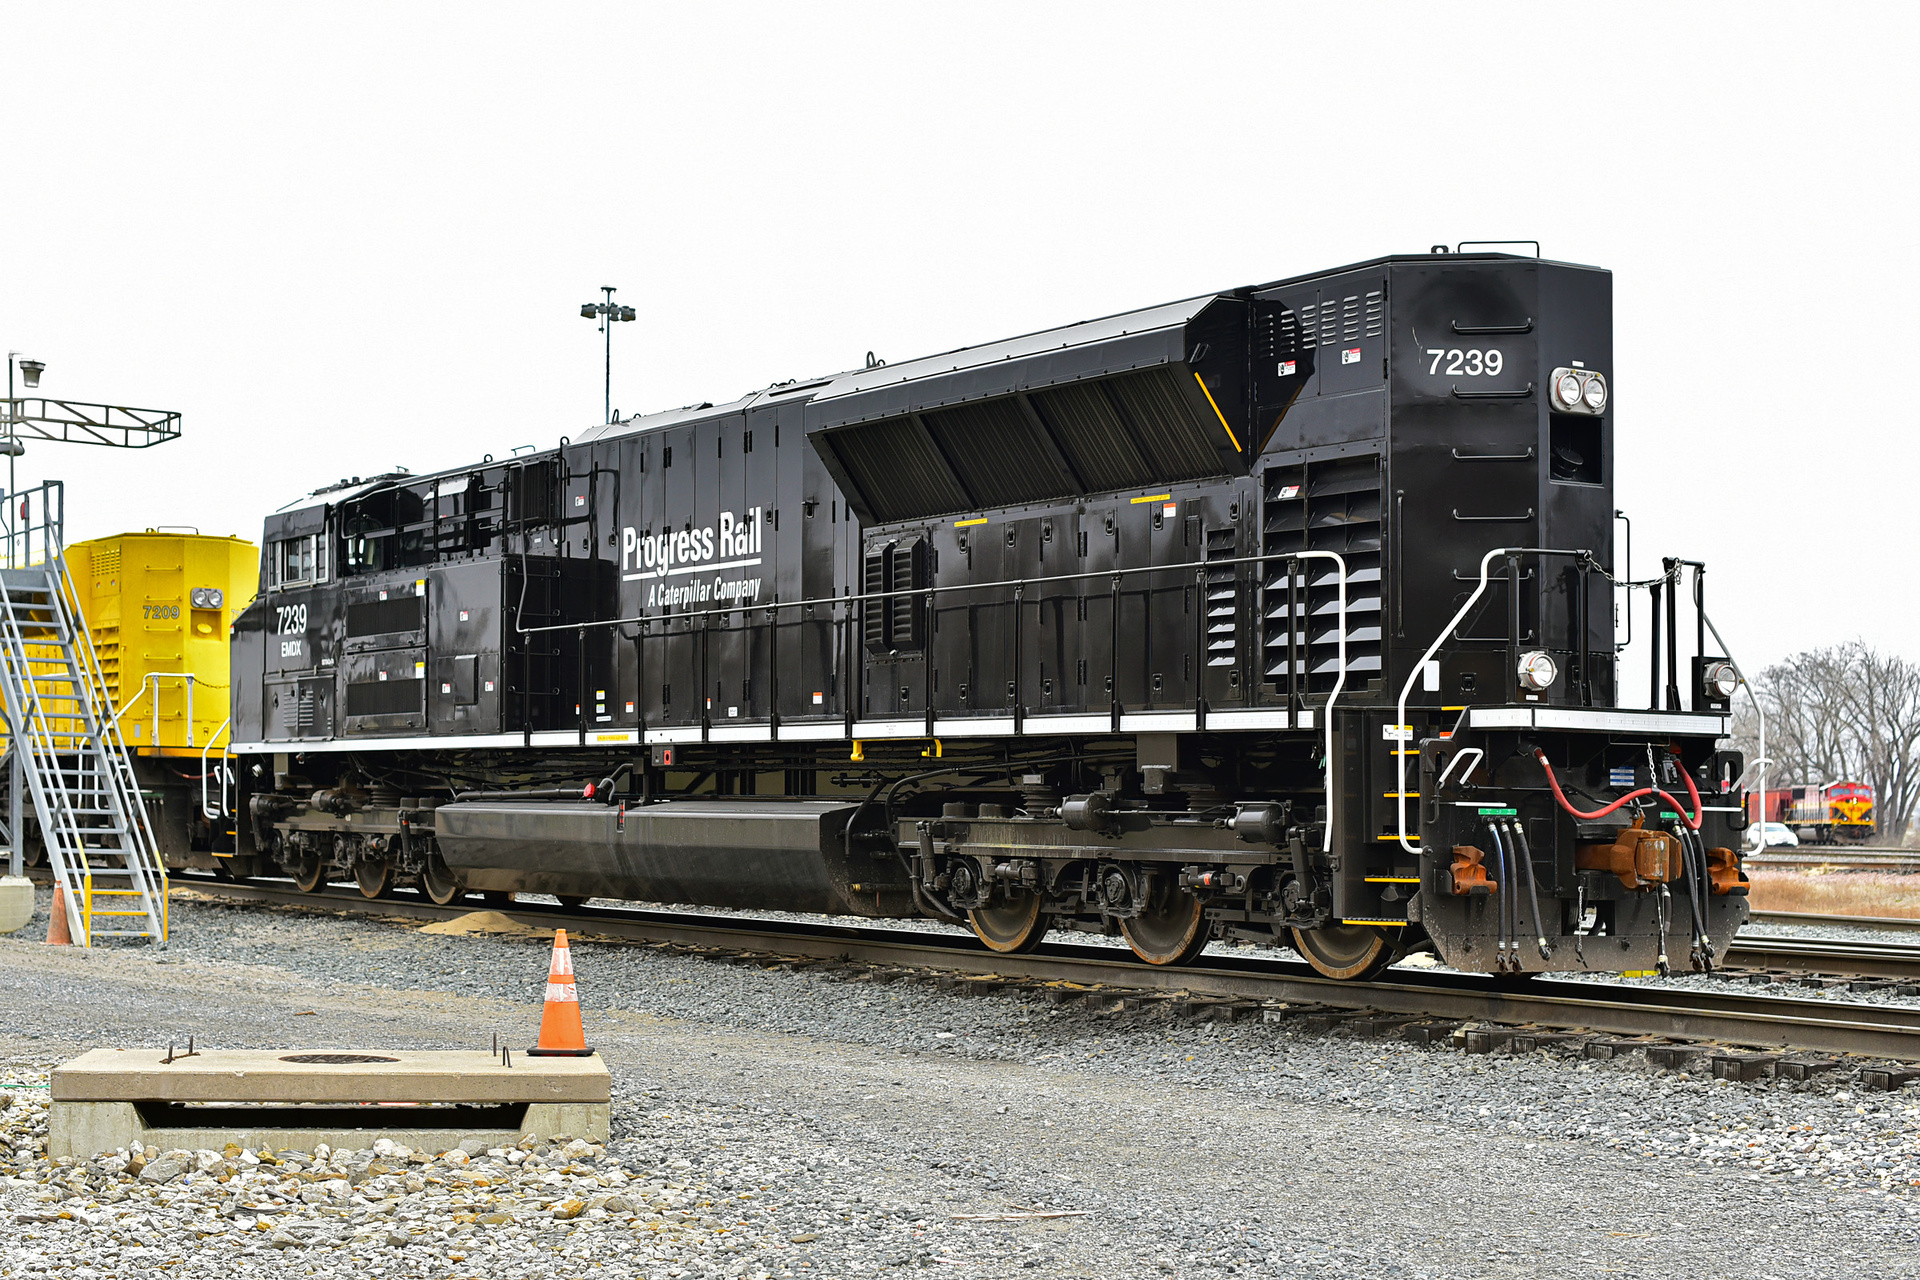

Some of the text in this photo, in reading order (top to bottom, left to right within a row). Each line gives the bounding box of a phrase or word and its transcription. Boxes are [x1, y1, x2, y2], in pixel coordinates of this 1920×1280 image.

[1426, 349, 1503, 377] 7239
[623, 506, 762, 577] Progress Rail
[648, 576, 762, 610] A Caterpillar Company
[143, 605, 181, 619] 7209
[277, 603, 307, 637] 7239
[281, 640, 302, 658] EMDX
